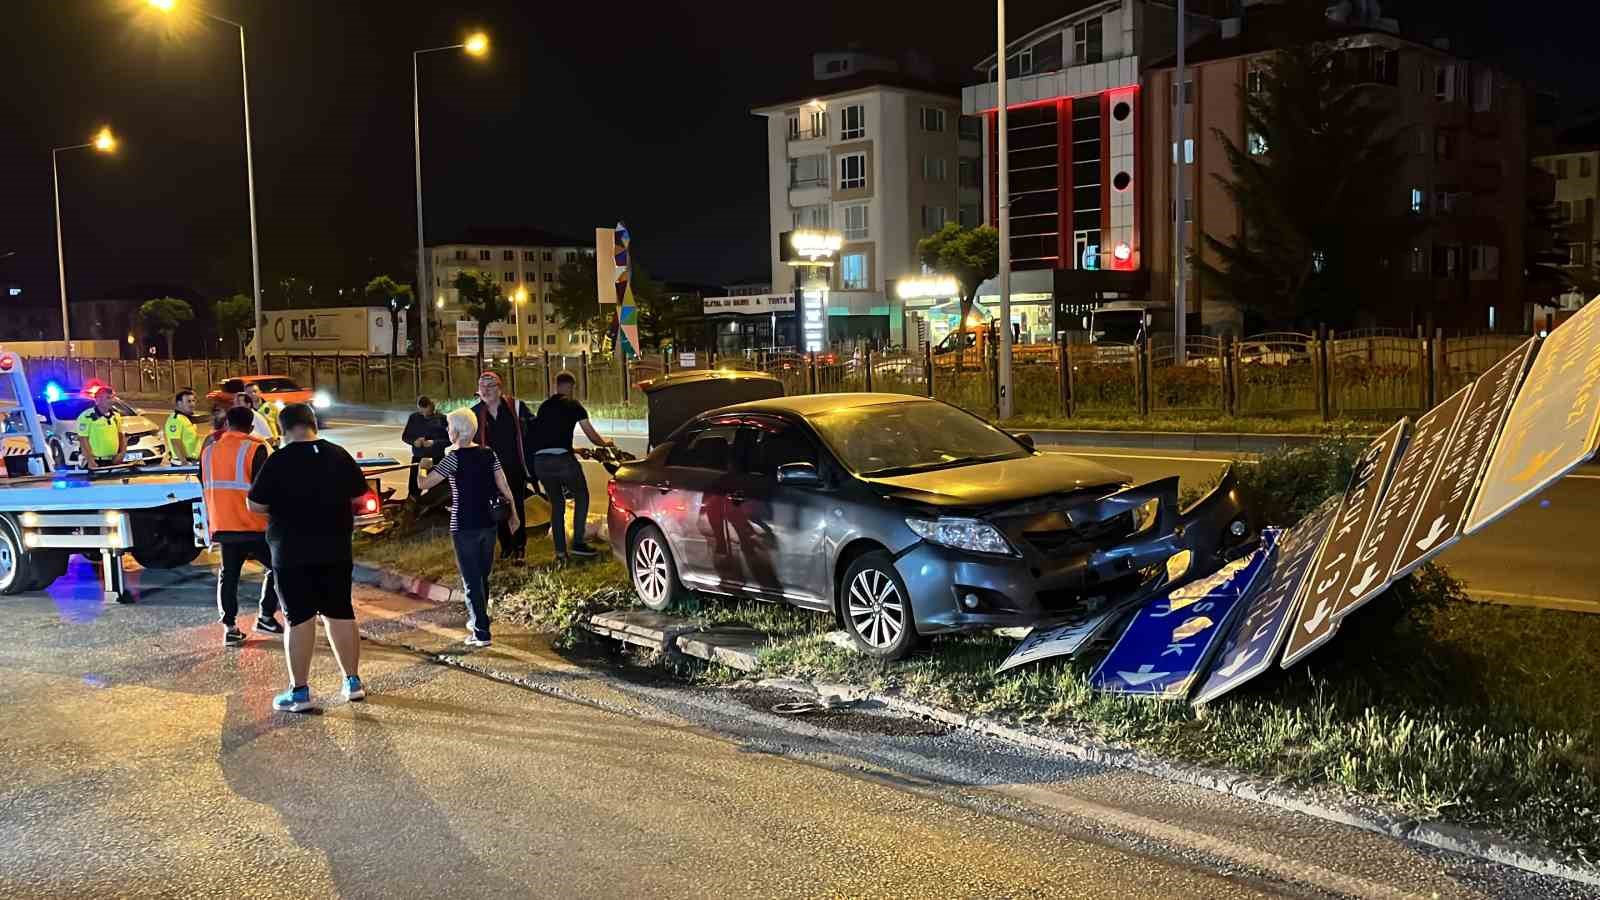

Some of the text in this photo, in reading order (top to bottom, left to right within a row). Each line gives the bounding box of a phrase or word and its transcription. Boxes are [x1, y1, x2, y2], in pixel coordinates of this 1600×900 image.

[1317, 440, 1386, 595] Gölcük 13
[1362, 415, 1437, 562] Tarihi Evler 50
[1397, 427, 1446, 517] Mudurnu
[1440, 458, 1461, 481] 95
